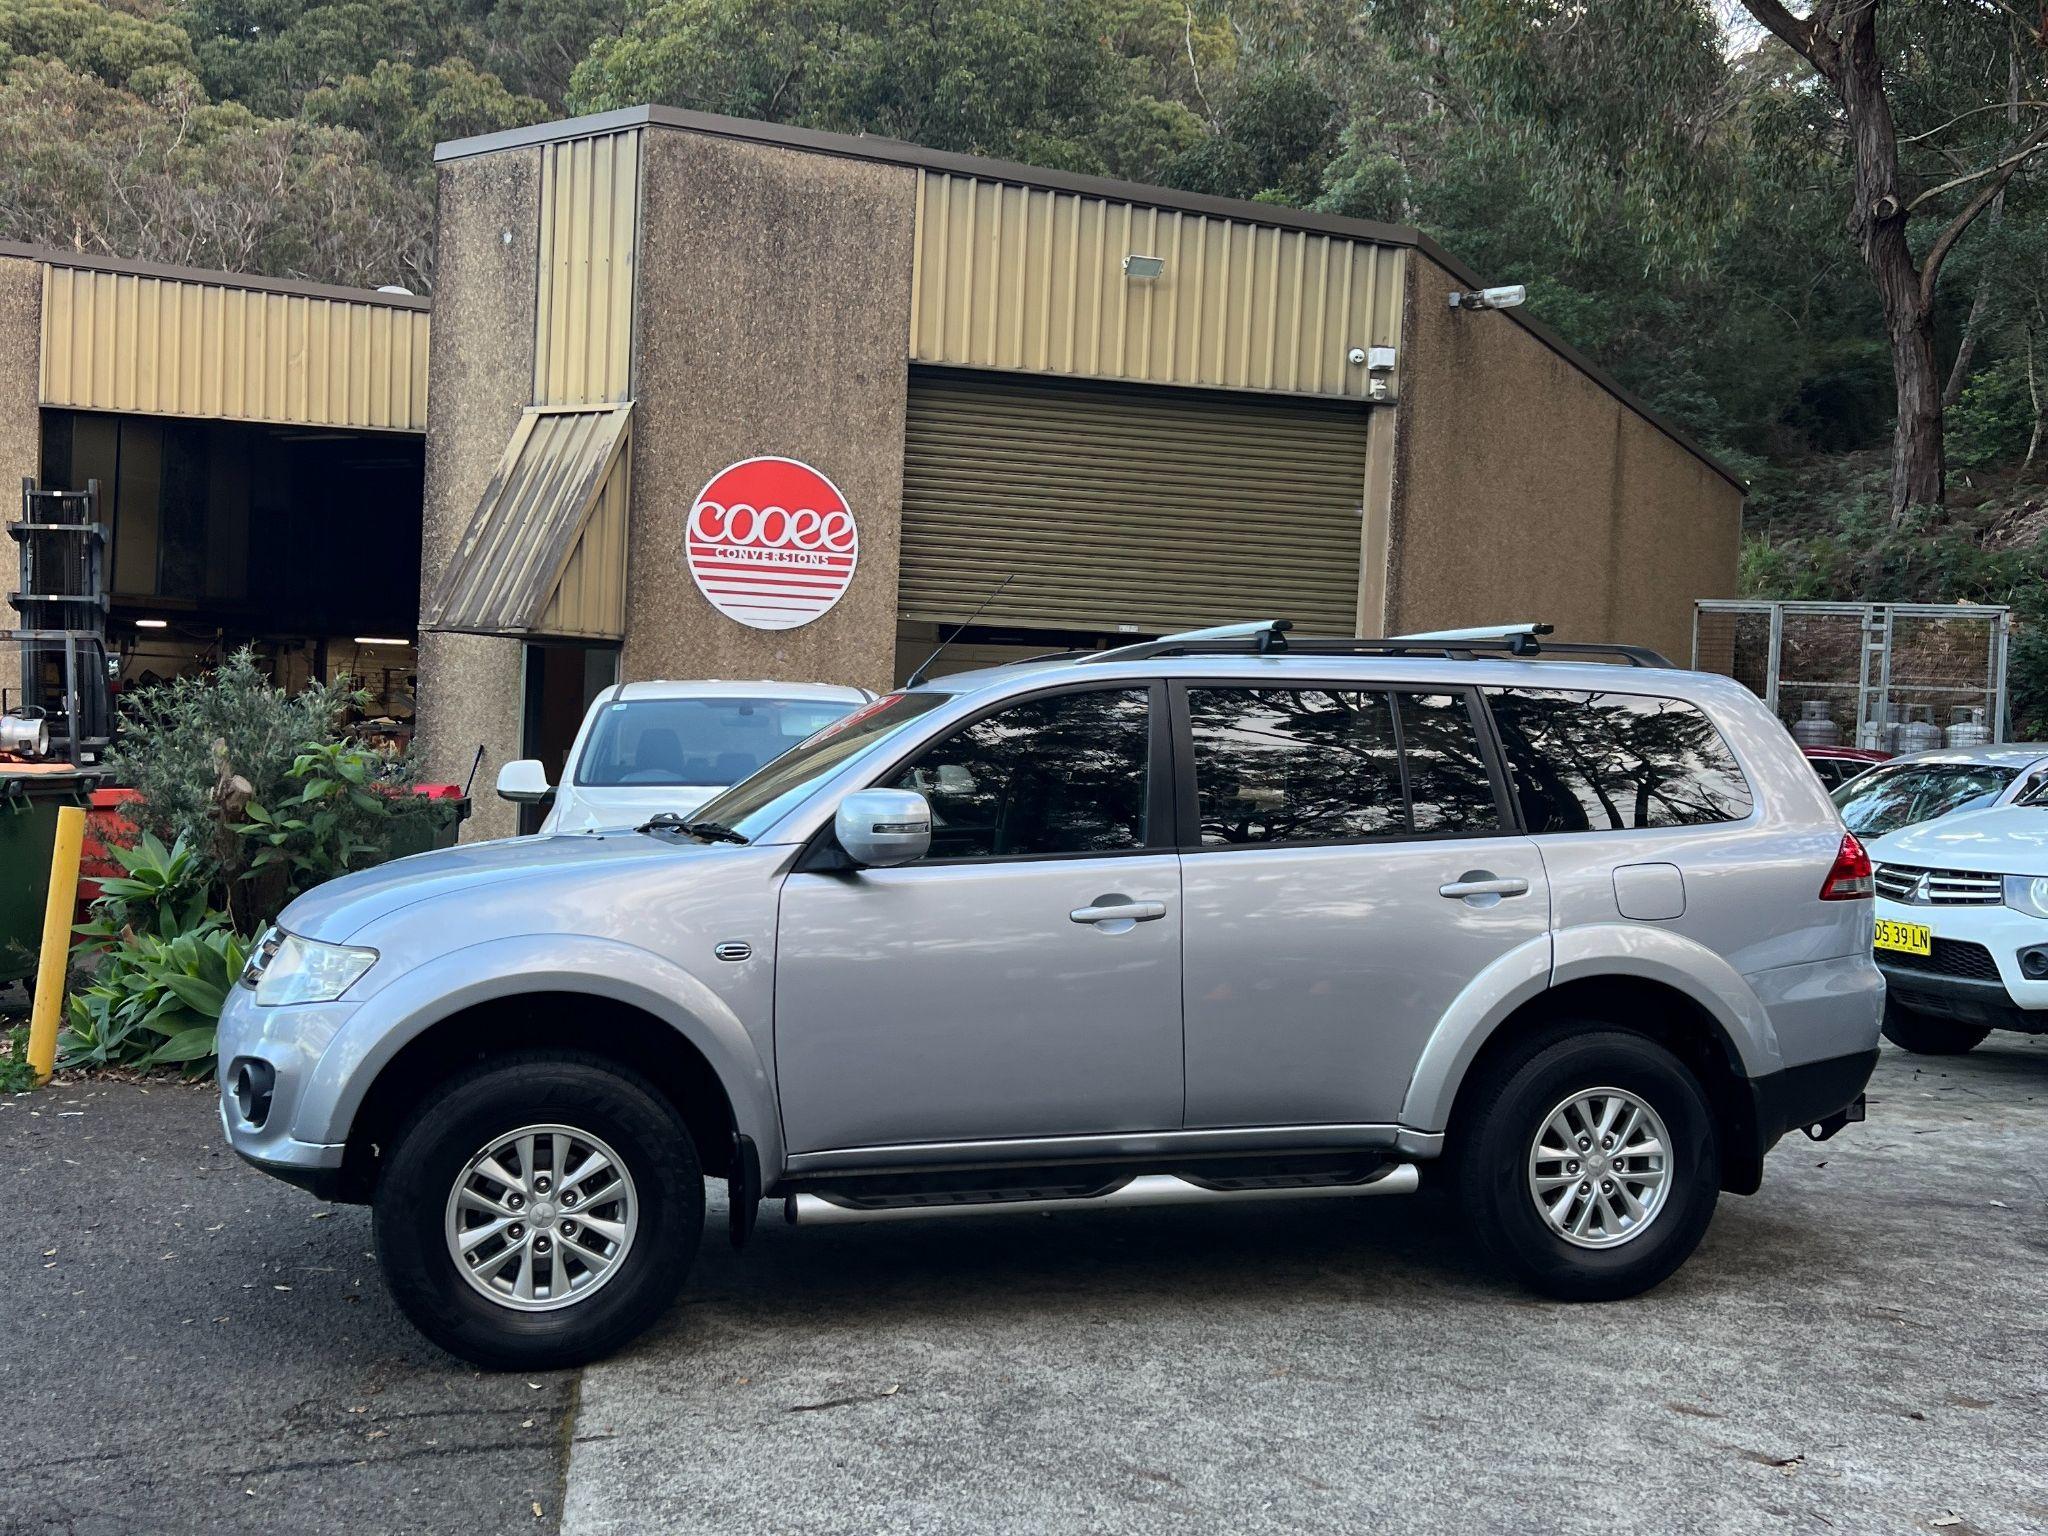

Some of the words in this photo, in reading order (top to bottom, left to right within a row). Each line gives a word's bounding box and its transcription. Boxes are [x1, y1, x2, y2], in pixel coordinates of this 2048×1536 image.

[715, 547, 829, 565] CONVERSIONS
[1893, 926, 1908, 945] 39
[1912, 929, 1928, 949] LN
